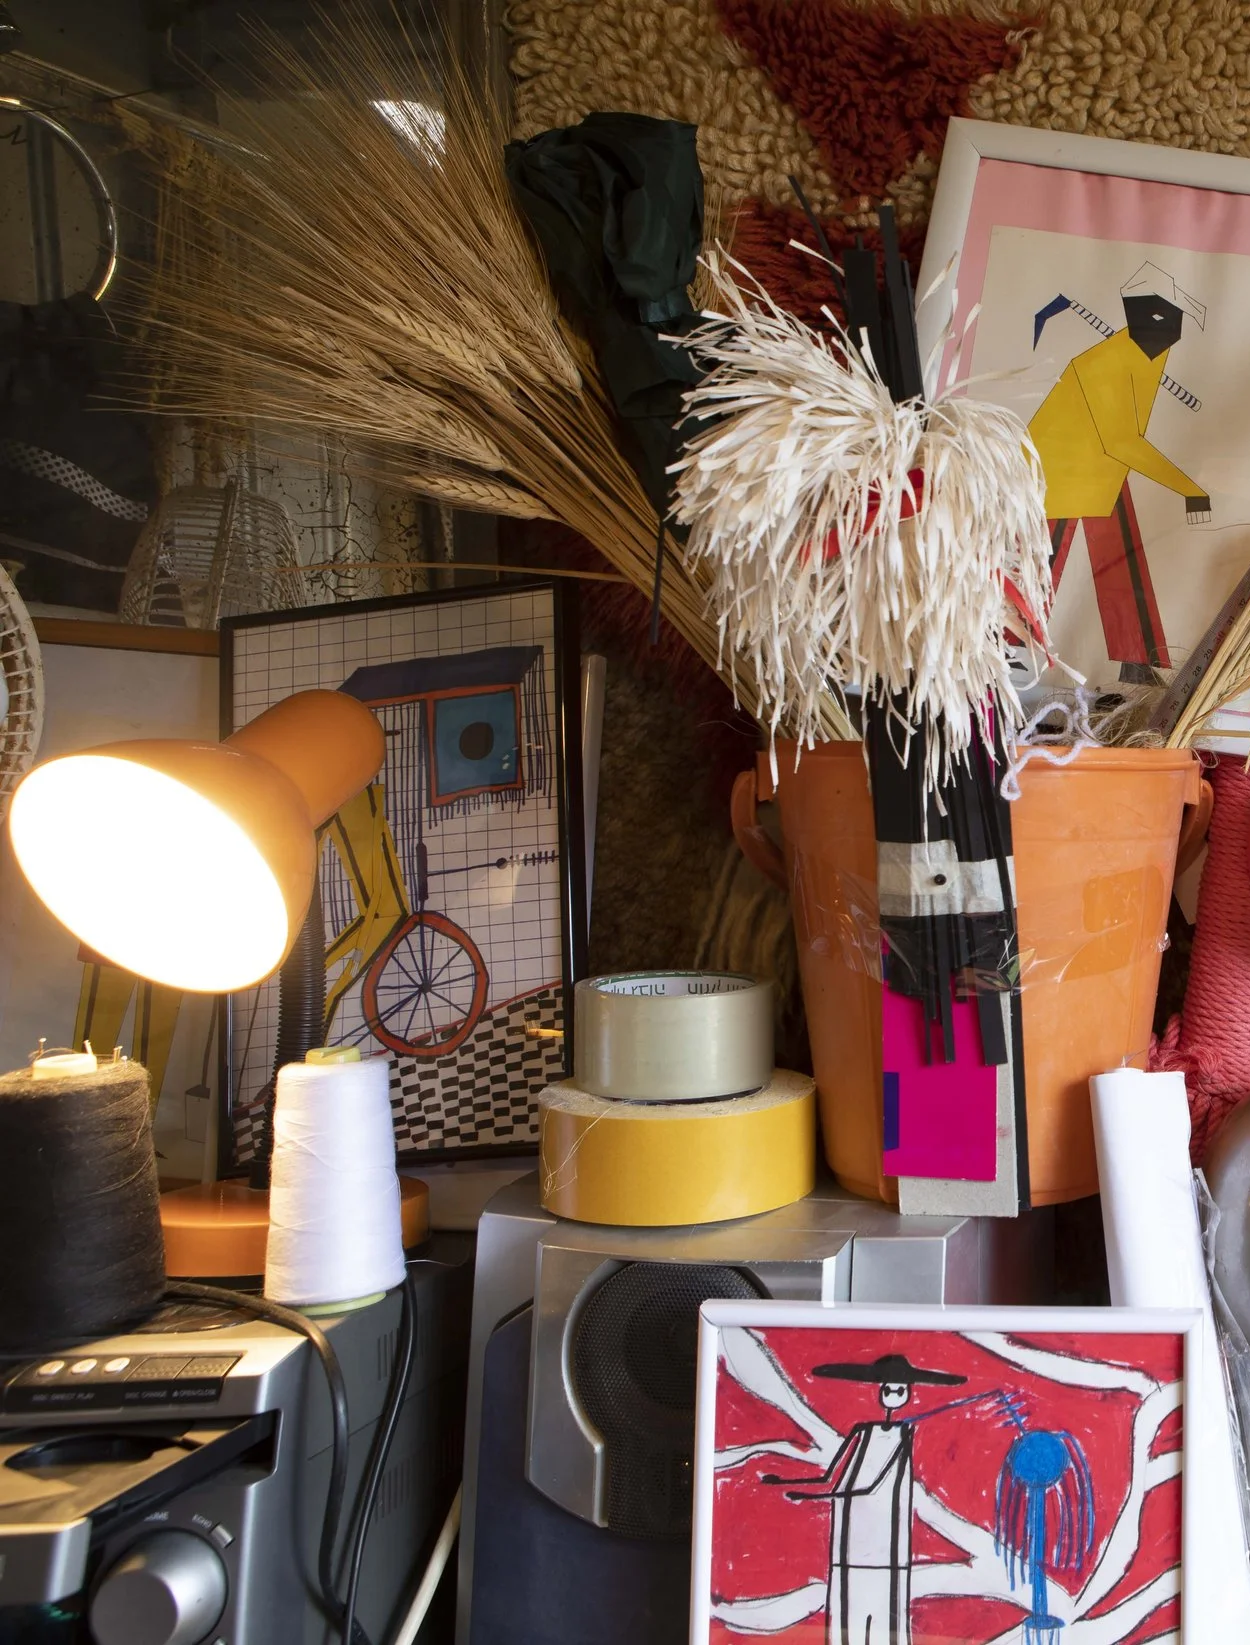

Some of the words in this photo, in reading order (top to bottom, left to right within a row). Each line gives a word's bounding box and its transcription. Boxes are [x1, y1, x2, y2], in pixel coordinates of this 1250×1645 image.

[1160, 718, 1169, 729] 25
[1169, 700, 1179, 711] 26
[1181, 683, 1191, 694] 27
[1192, 666, 1202, 677] 28
[1203, 648, 1213, 660] 29
[1226, 615, 1236, 626] 31
[1239, 597, 1248, 608] 32
